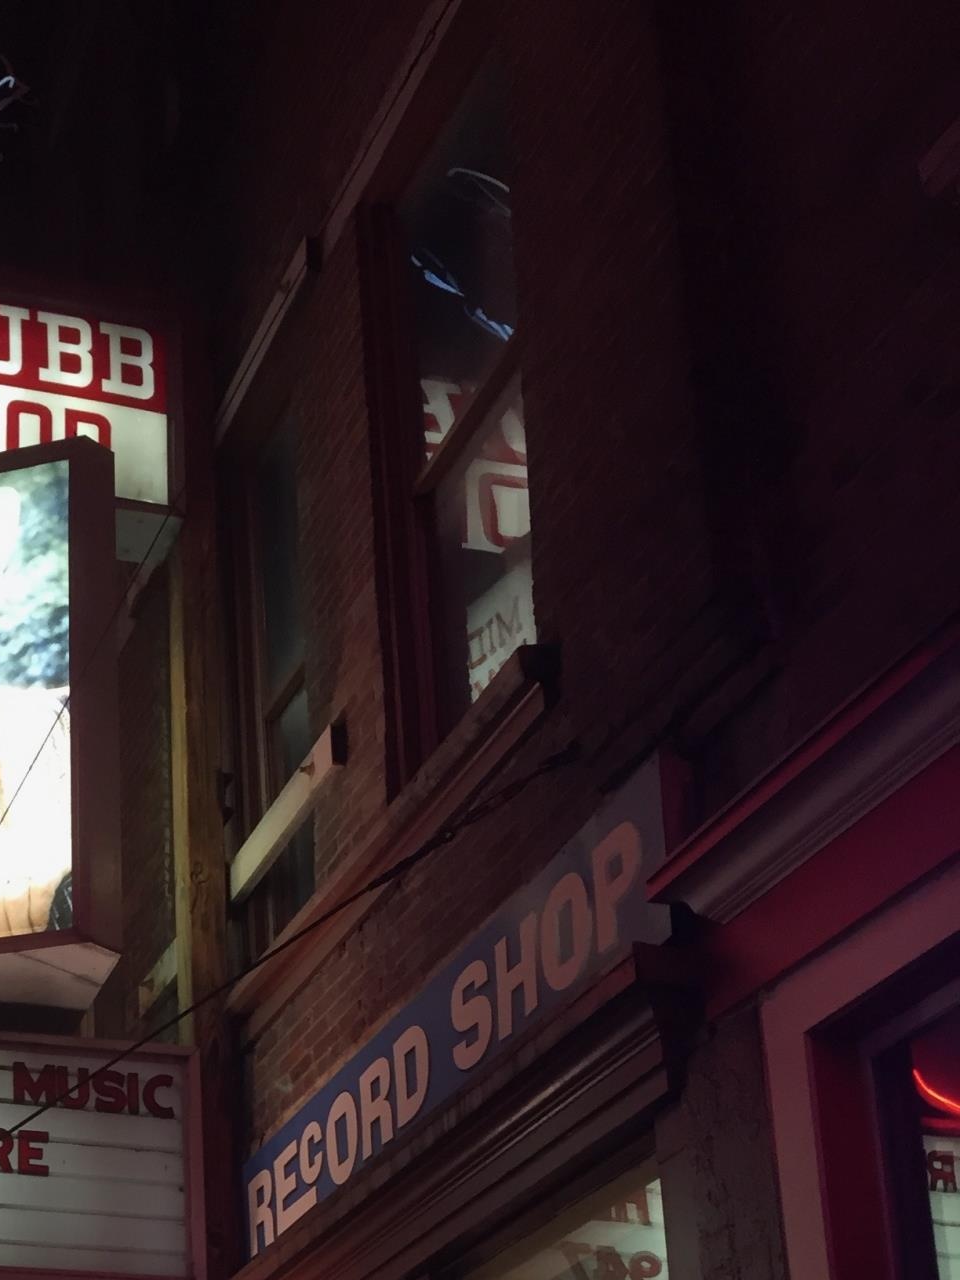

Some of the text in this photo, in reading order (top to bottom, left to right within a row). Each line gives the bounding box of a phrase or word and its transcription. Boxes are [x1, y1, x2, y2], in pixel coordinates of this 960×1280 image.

[12, 1061, 176, 1120] MUSIC
[247, 820, 642, 1257] RECORD SHOP
